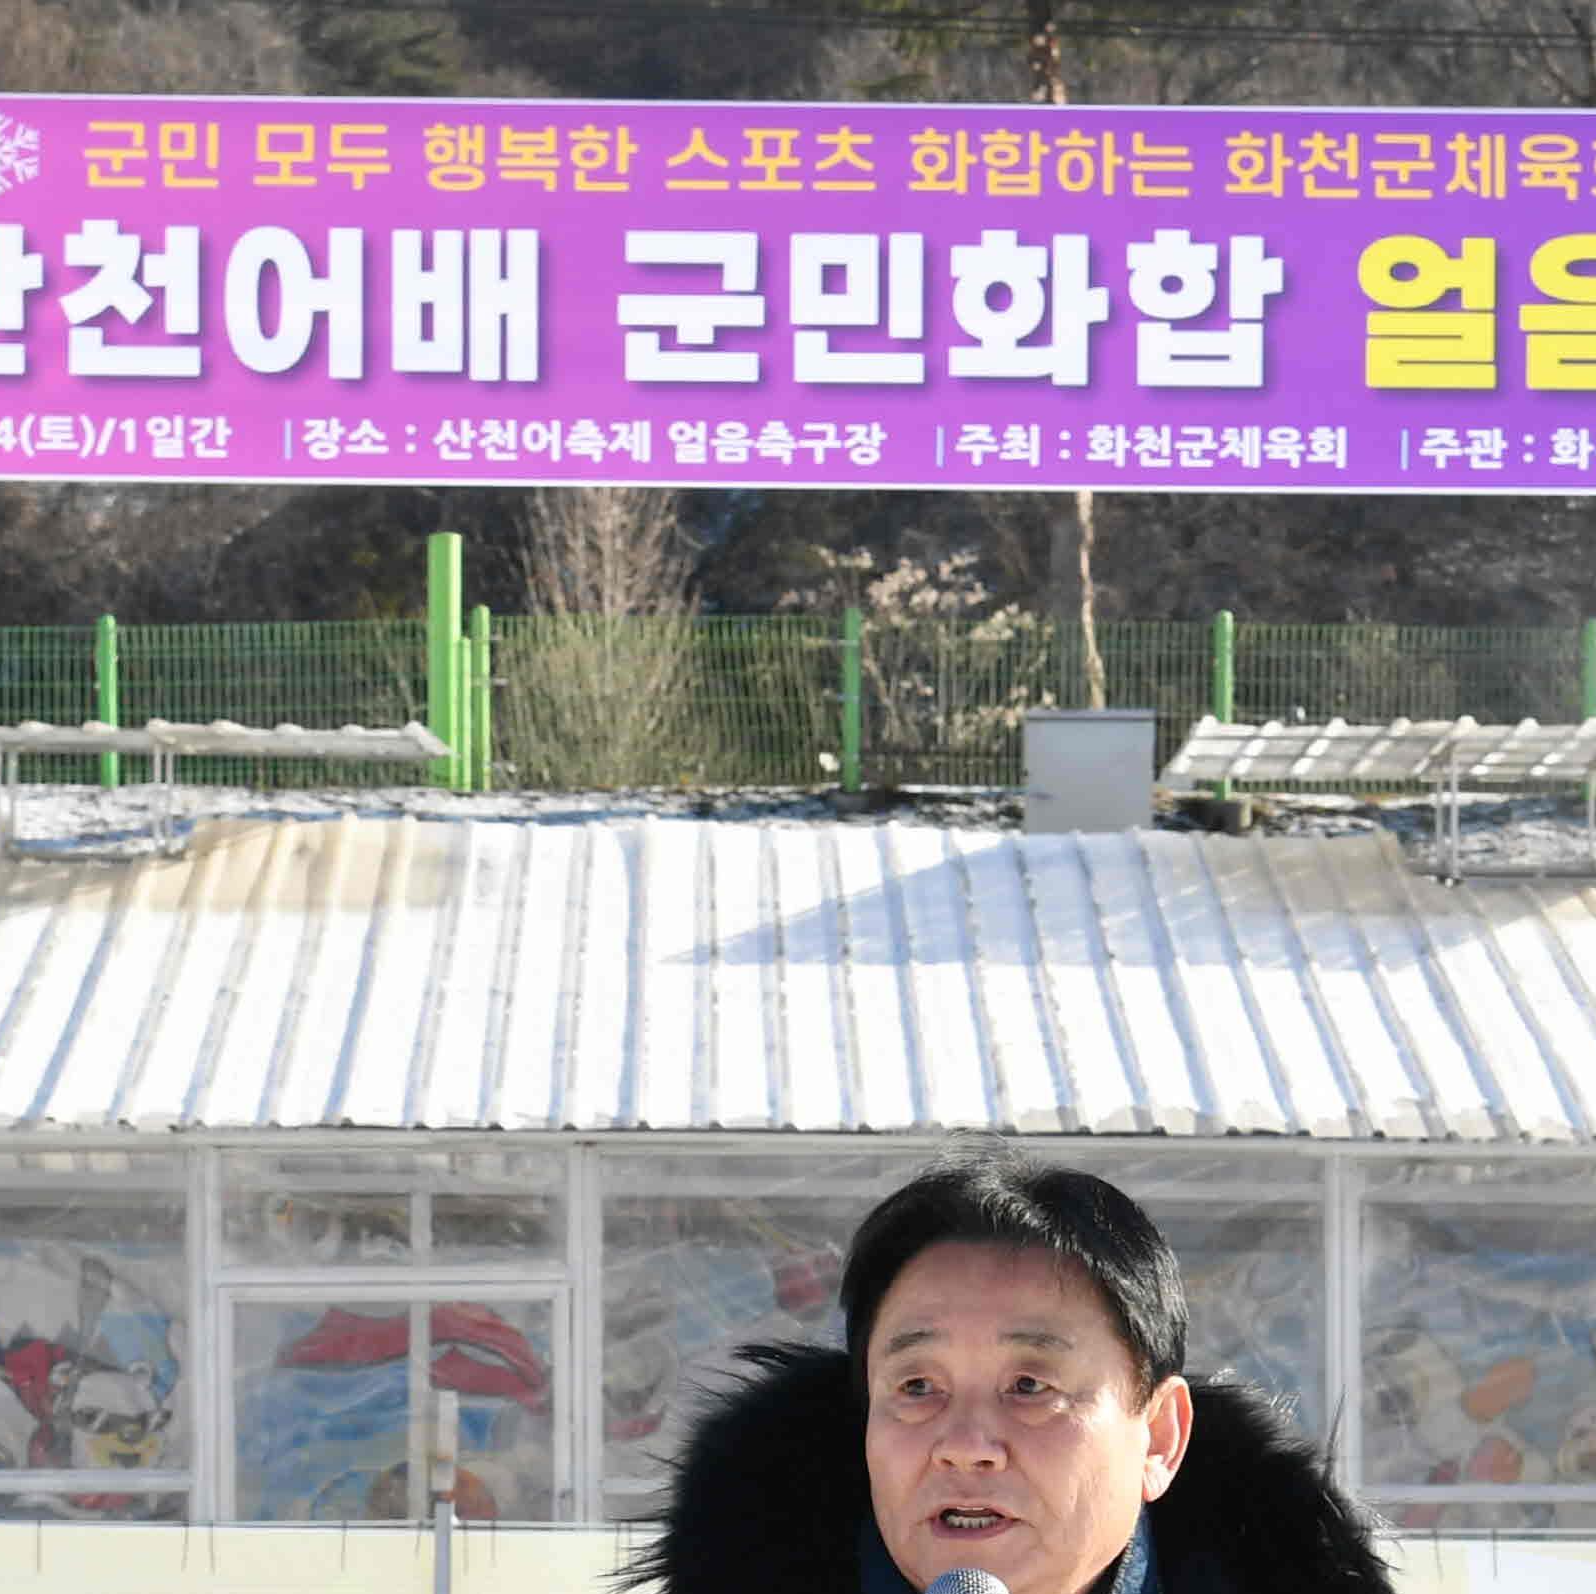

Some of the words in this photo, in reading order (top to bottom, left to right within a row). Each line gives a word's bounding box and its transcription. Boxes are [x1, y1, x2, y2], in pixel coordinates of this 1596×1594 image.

[84, 119, 221, 190] 군민
[254, 122, 393, 190] 모두
[423, 122, 639, 194] 행복한
[666, 125, 878, 193] 스포츠
[909, 127, 1195, 198] 화합하는
[616, 228, 1284, 388] 군민화합
[301, 416, 391, 462] 장소
[431, 417, 653, 465] 산천어축제
[666, 419, 889, 467] 얼음축구장
[954, 422, 1042, 468] 주최
[1084, 423, 1348, 470] 화천군체육회
[1417, 426, 1509, 471] 주관
